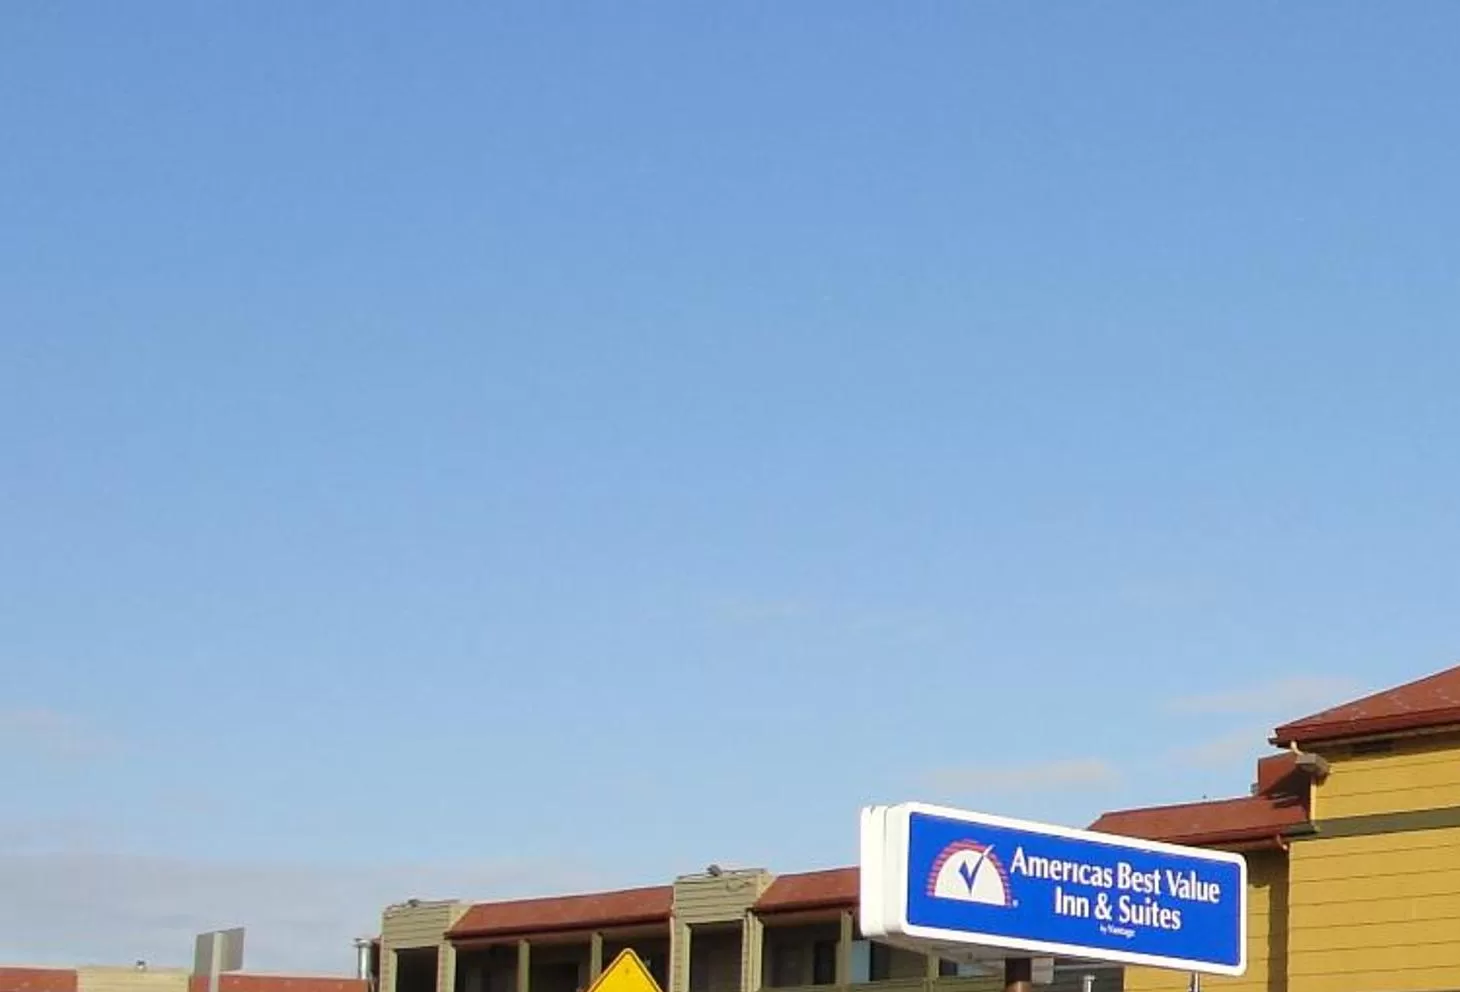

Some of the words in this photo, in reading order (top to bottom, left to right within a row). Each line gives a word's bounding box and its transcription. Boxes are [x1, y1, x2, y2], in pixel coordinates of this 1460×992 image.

[1010, 846, 1113, 888] Americas
[1117, 862, 1161, 895] Best
[1166, 869, 1220, 903] Value
[1055, 886, 1089, 918] Inn
[1094, 893, 1112, 920] &
[1119, 895, 1181, 930] Suites
